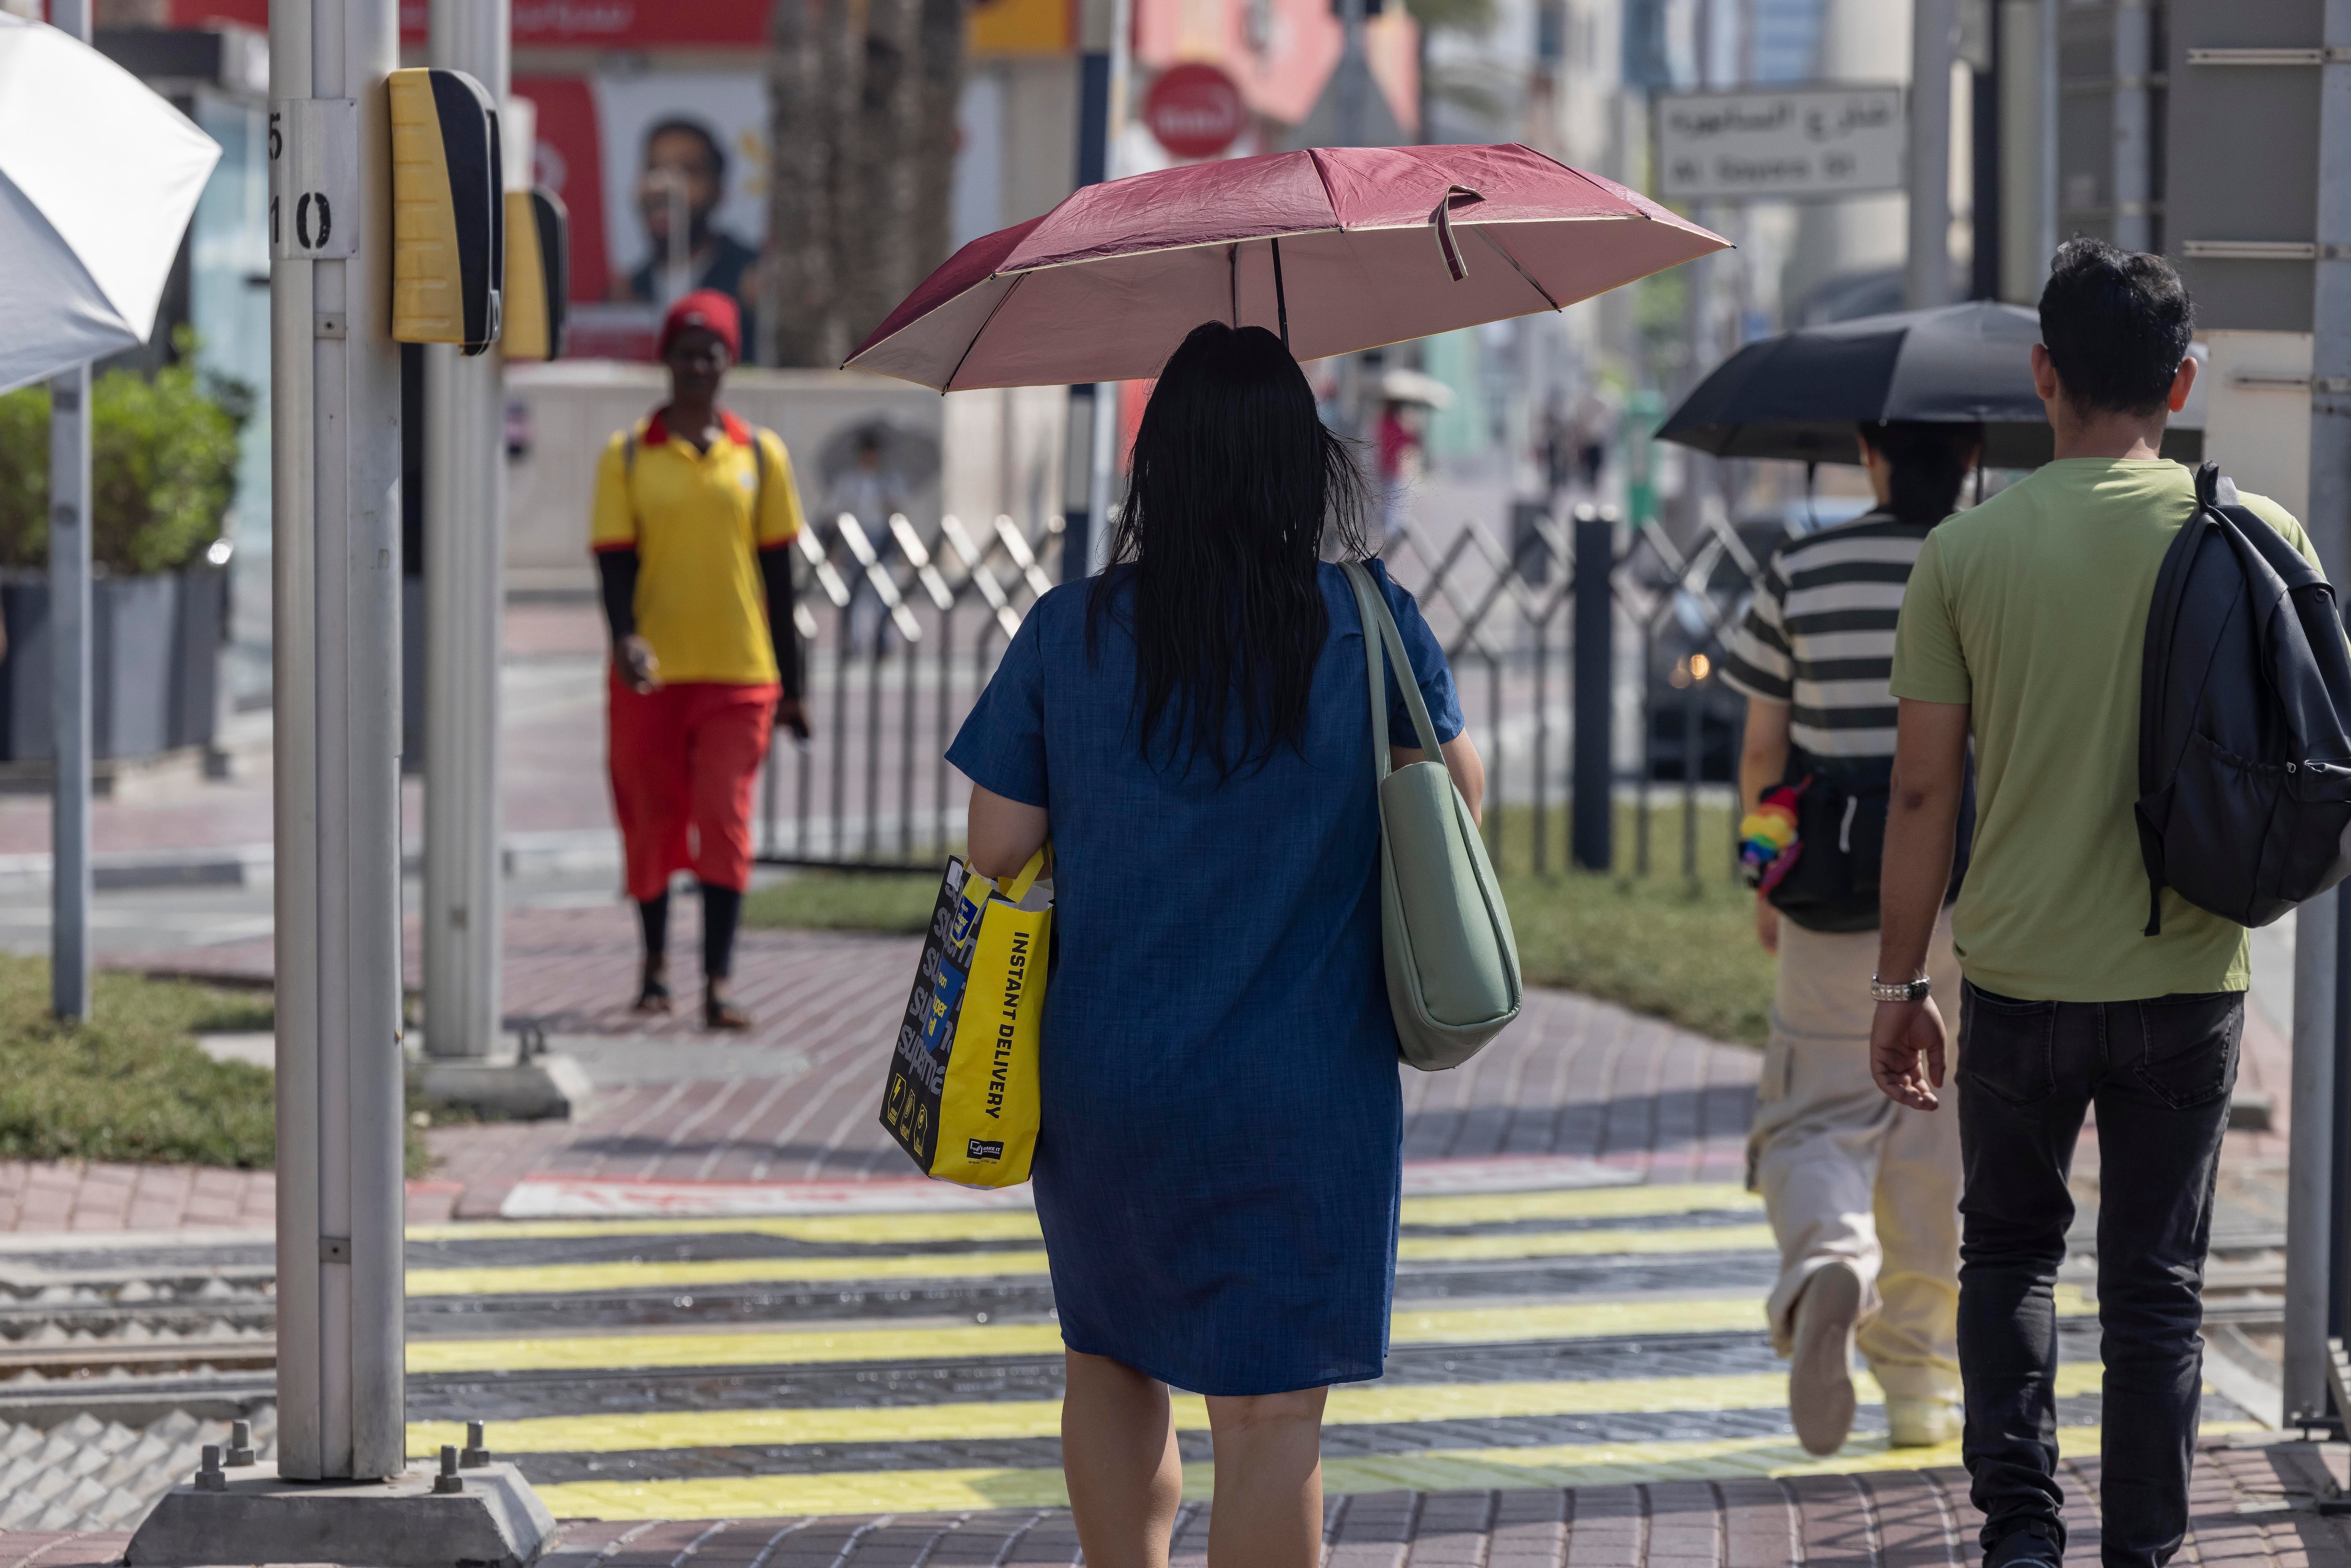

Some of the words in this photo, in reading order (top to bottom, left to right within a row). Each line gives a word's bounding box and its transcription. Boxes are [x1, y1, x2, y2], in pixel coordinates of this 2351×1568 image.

[270, 192, 331, 249] 10
[957, 913, 968, 926] super
[1002, 931, 1030, 1020] INSTANT
[933, 993, 947, 1018] uper
[928, 1016, 937, 1037] all
[986, 1024, 1015, 1119] DELIVERY
